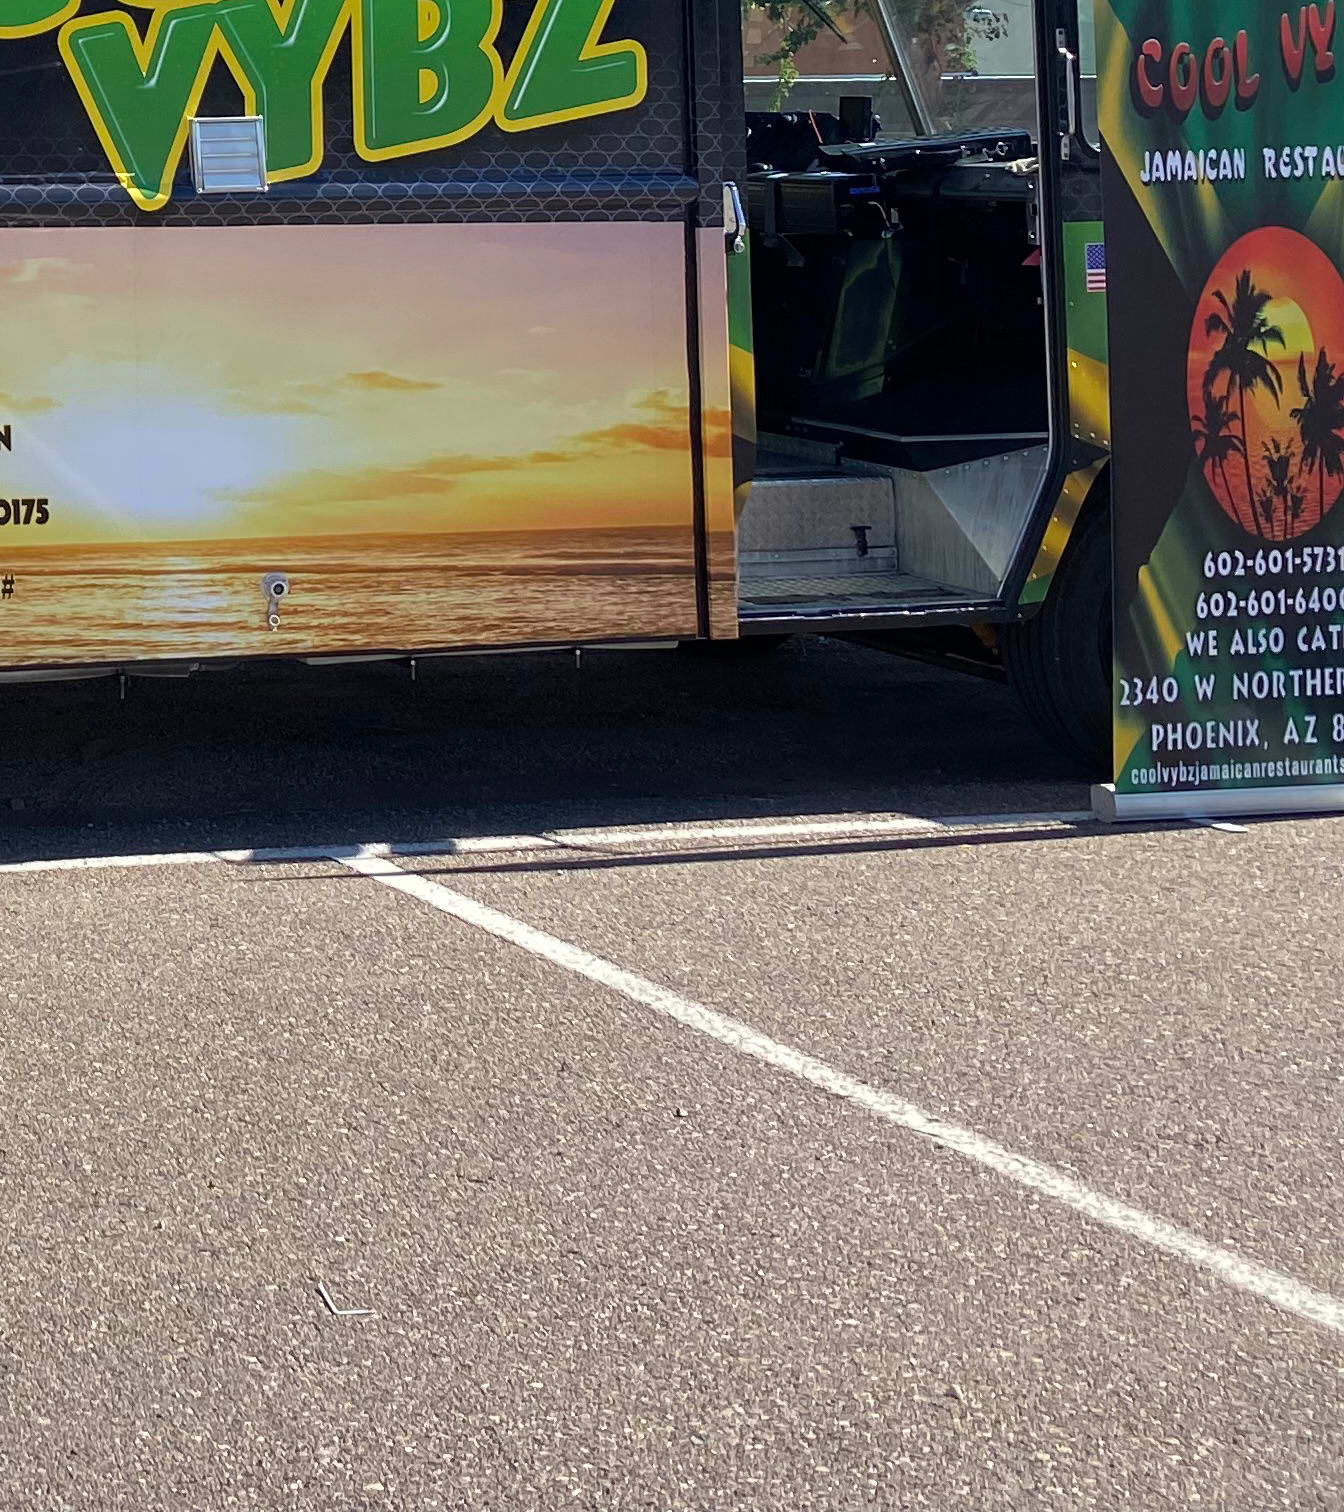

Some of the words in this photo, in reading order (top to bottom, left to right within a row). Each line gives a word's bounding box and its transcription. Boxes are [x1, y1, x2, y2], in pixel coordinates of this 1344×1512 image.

[1137, 29, 1260, 112] COOL
[1140, 148, 1246, 182] JAMAICAN
[1186, 629, 1218, 657] WE
[1230, 627, 1285, 655] ALSO
[1297, 624, 1344, 652] CAT
[1120, 675, 1178, 706] 2340
[1194, 674, 1216, 701] W
[1151, 718, 1269, 751] PHOENIX,
[1283, 715, 1318, 745] AZ
